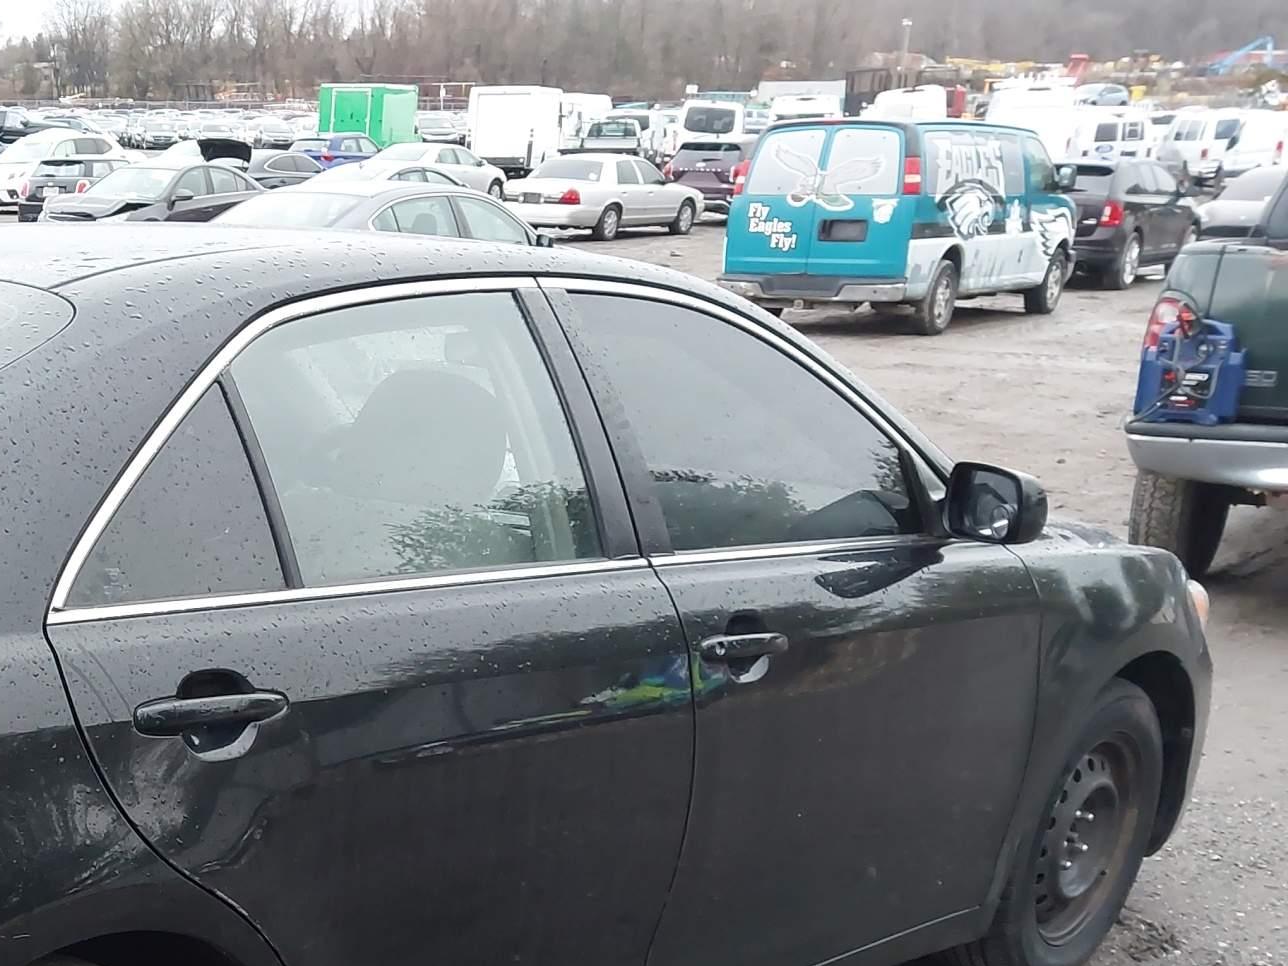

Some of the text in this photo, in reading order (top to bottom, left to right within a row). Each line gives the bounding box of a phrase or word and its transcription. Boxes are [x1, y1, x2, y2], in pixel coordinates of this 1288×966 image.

[932, 138, 1005, 201] EAGLES
[748, 202, 770, 220] Fly
[748, 217, 793, 236] Eagles
[769, 232, 798, 251] Fly!
